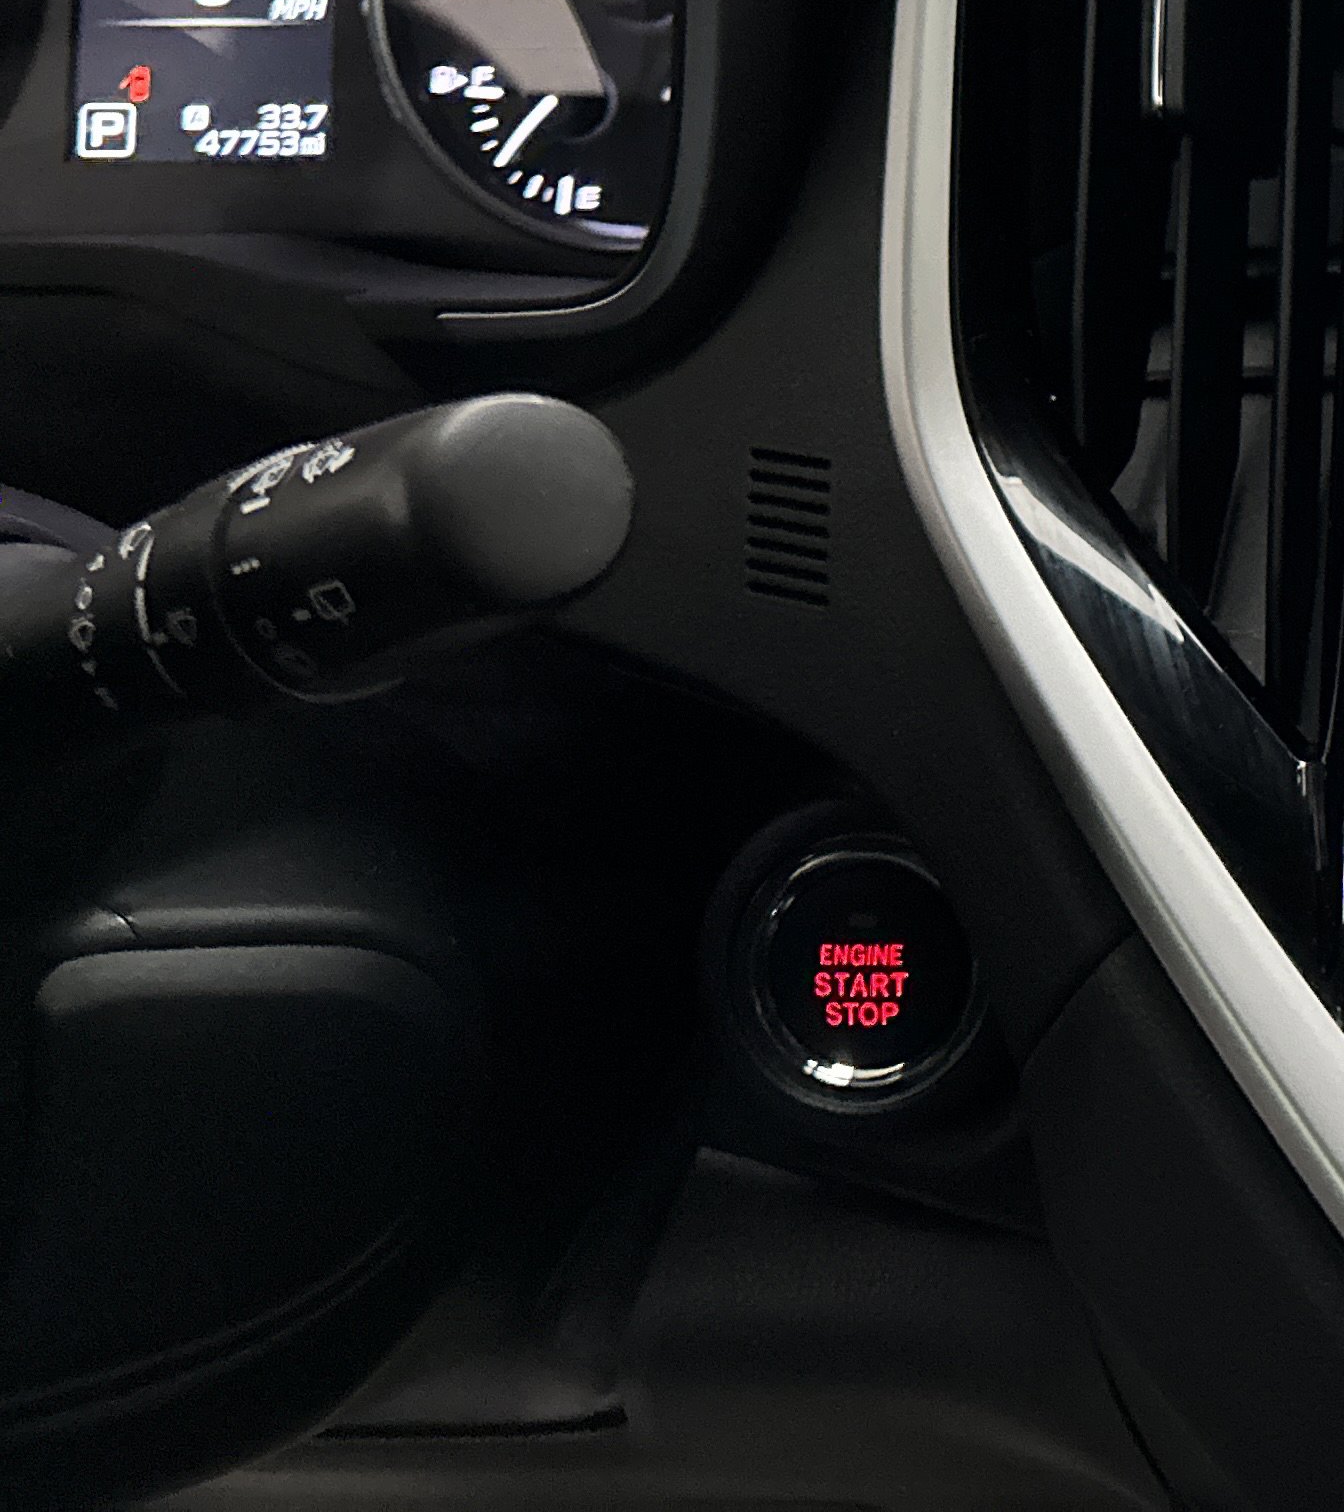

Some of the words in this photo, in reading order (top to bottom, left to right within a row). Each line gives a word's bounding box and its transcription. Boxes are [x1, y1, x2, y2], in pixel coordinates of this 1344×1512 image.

[90, 111, 125, 148] P
[256, 103, 329, 131] 33.7
[819, 944, 903, 966] ENGINE
[814, 972, 909, 998] START
[825, 1001, 899, 1026] STOP
